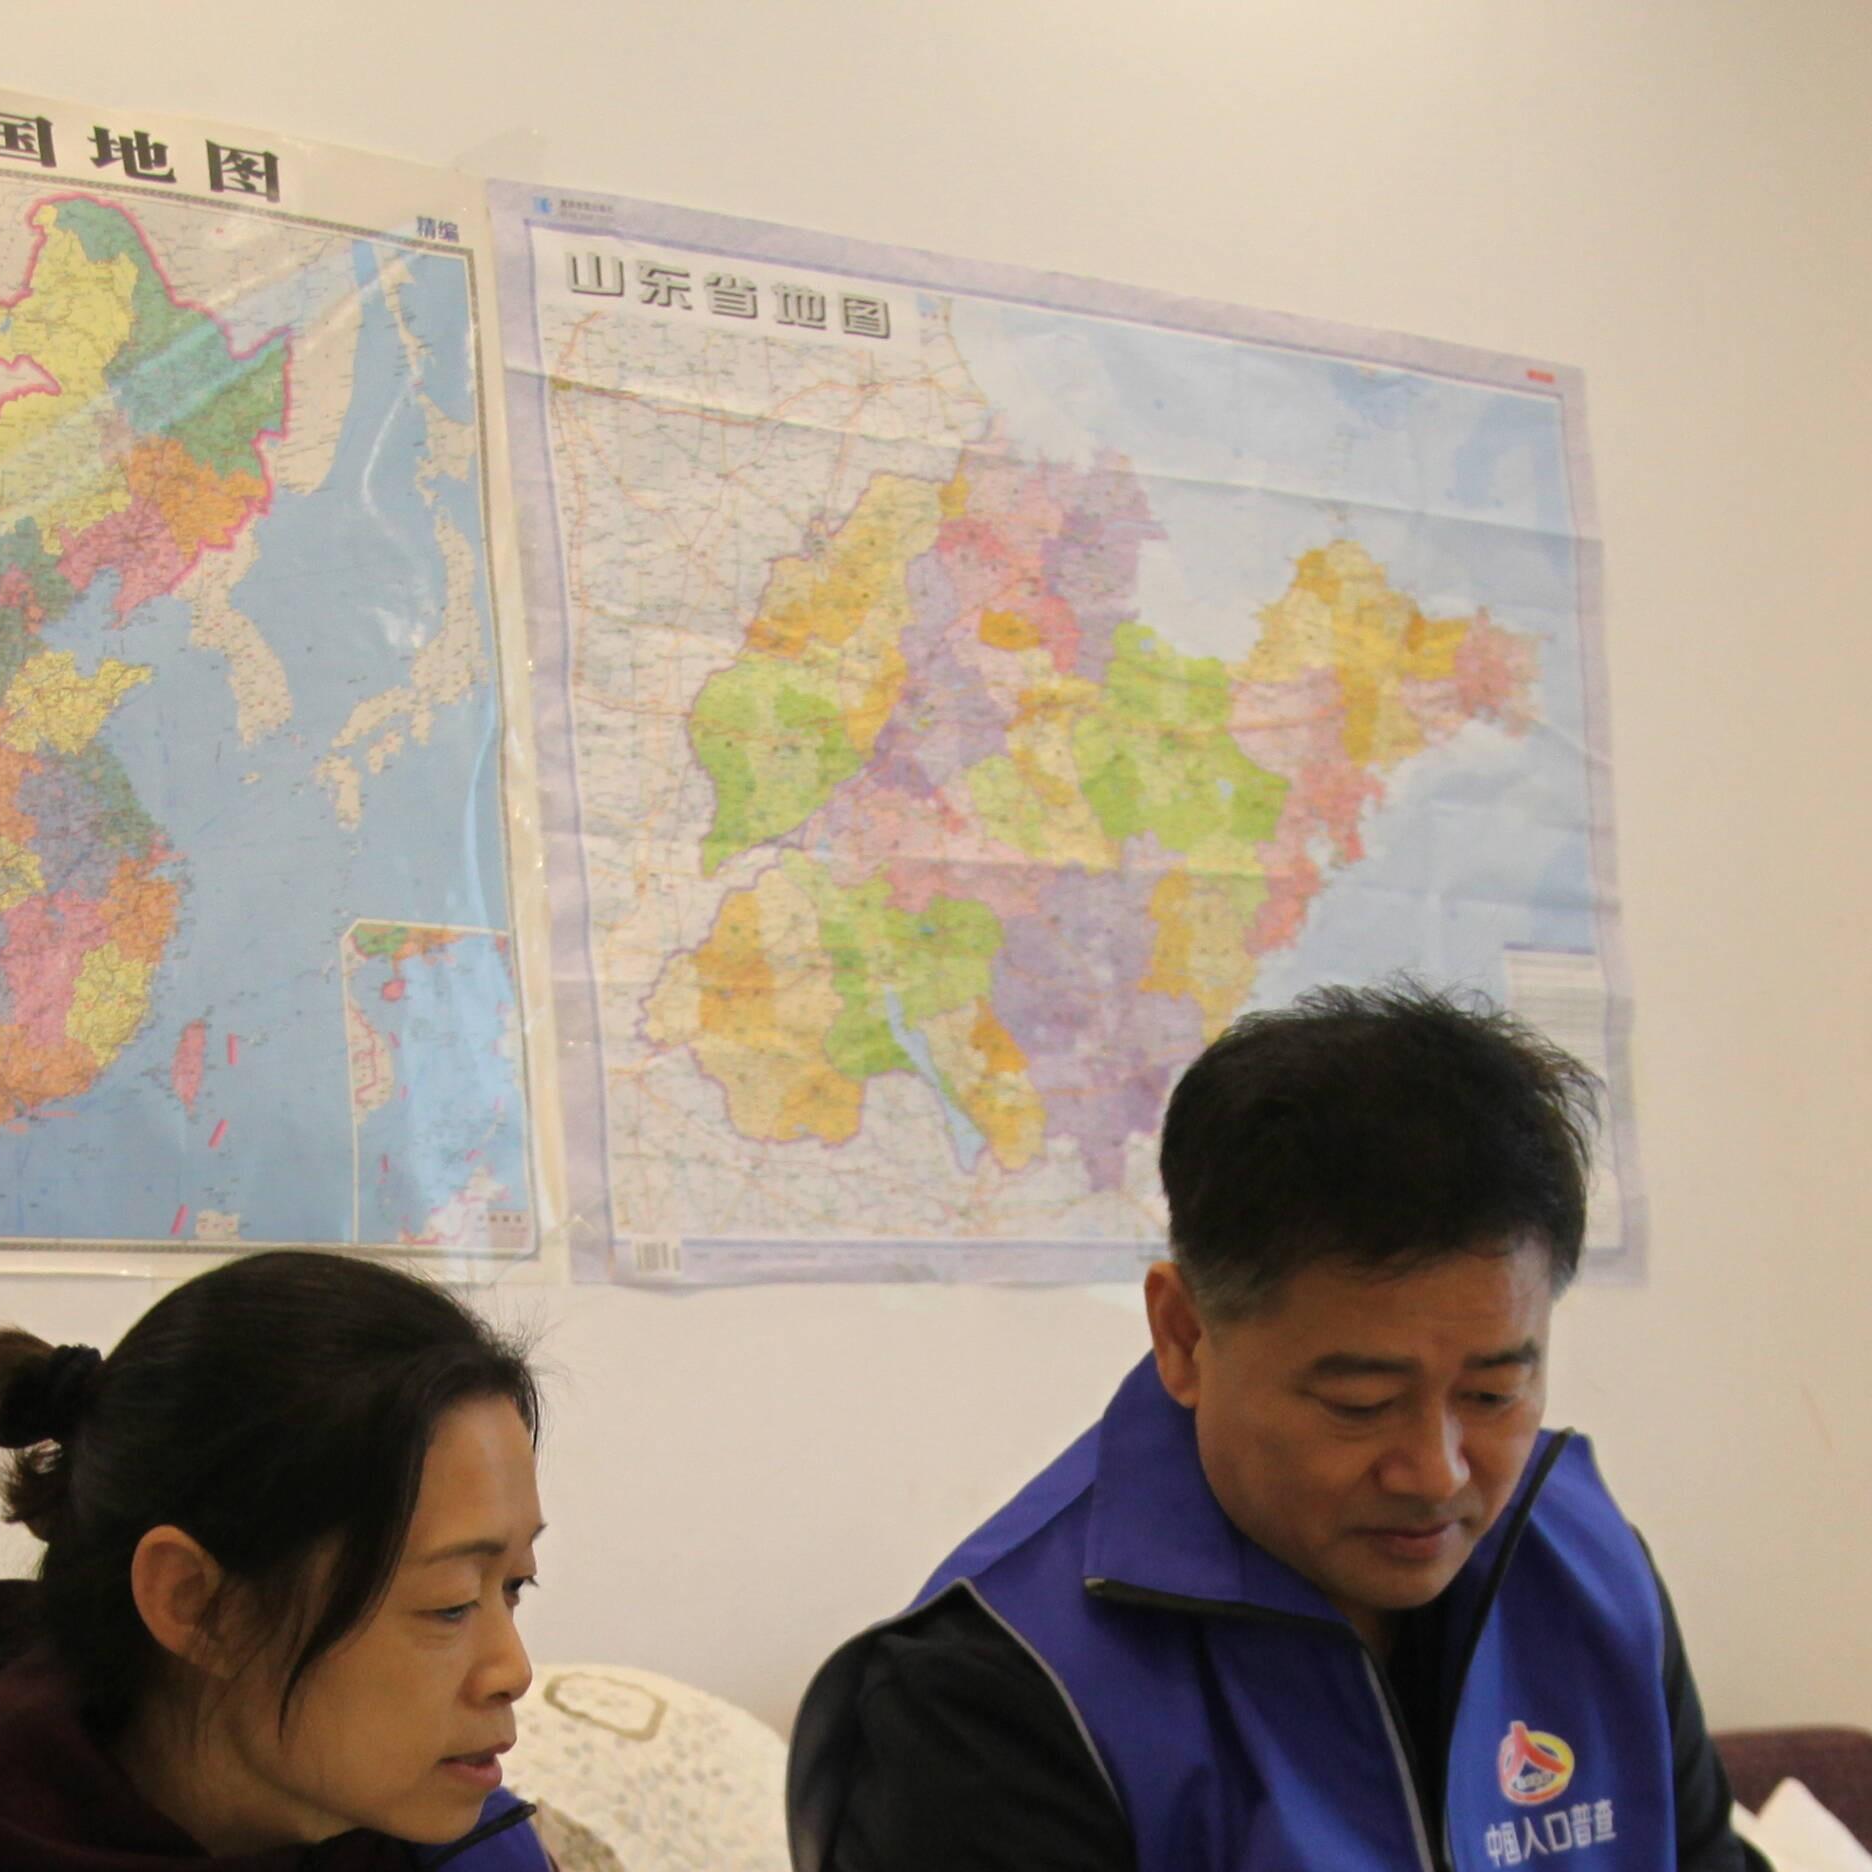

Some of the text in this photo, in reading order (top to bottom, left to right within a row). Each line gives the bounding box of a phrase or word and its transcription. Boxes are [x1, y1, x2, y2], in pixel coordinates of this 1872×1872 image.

[566, 252, 890, 339] 山东省地图
